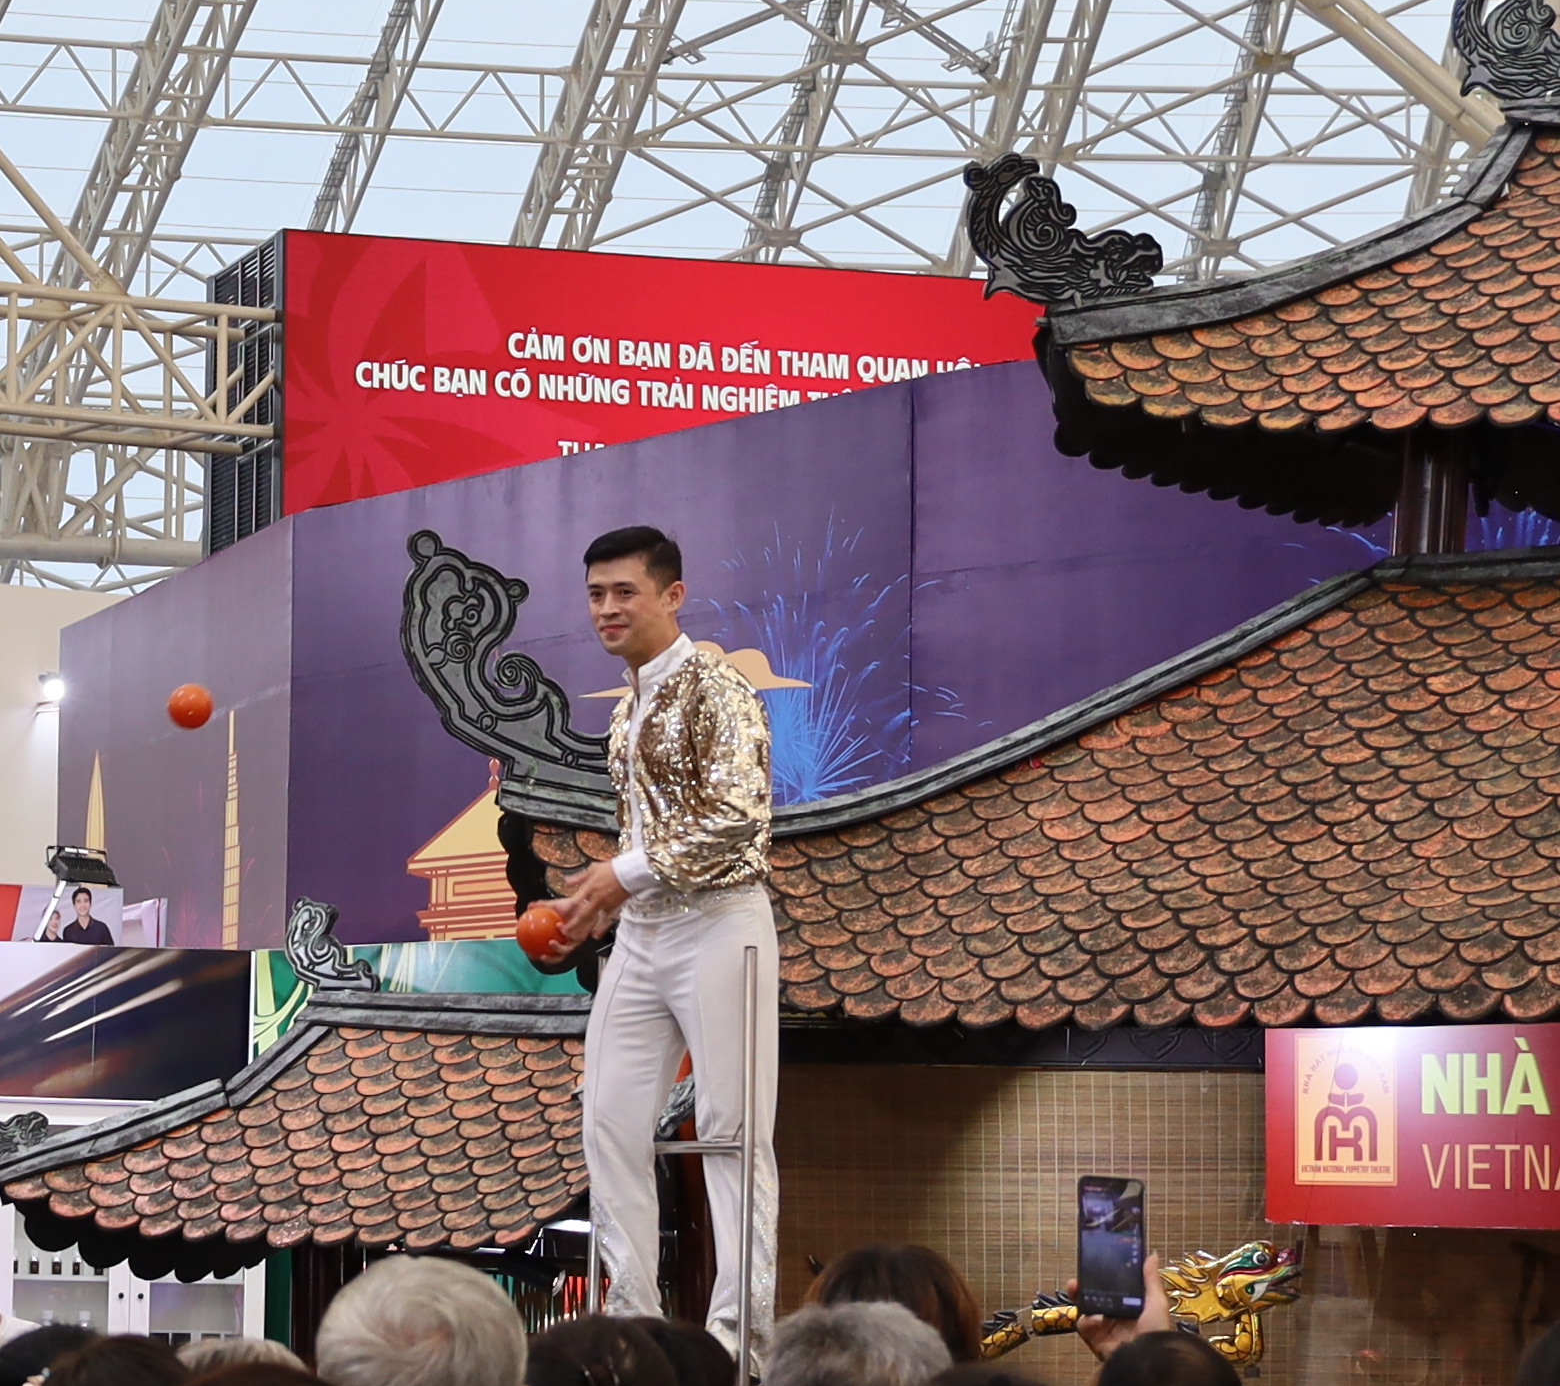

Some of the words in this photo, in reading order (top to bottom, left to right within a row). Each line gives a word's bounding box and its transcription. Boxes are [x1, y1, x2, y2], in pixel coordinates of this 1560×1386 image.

[508, 327, 564, 361] CẢM
[572, 335, 611, 364] ƠN
[619, 340, 671, 370] BẠN
[679, 341, 715, 372] ĐÃ
[721, 340, 771, 375] ĐẾN
[777, 350, 850, 380] THAM
[857, 355, 928, 383] QUAN
[355, 359, 426, 392] CHÚC
[433, 366, 487, 398] BẠN
[494, 368, 531, 398] CÓ
[539, 372, 631, 405] NHỮNG
[636, 376, 694, 409] TRẢI
[1421, 1036, 1551, 1116] NHÀ
